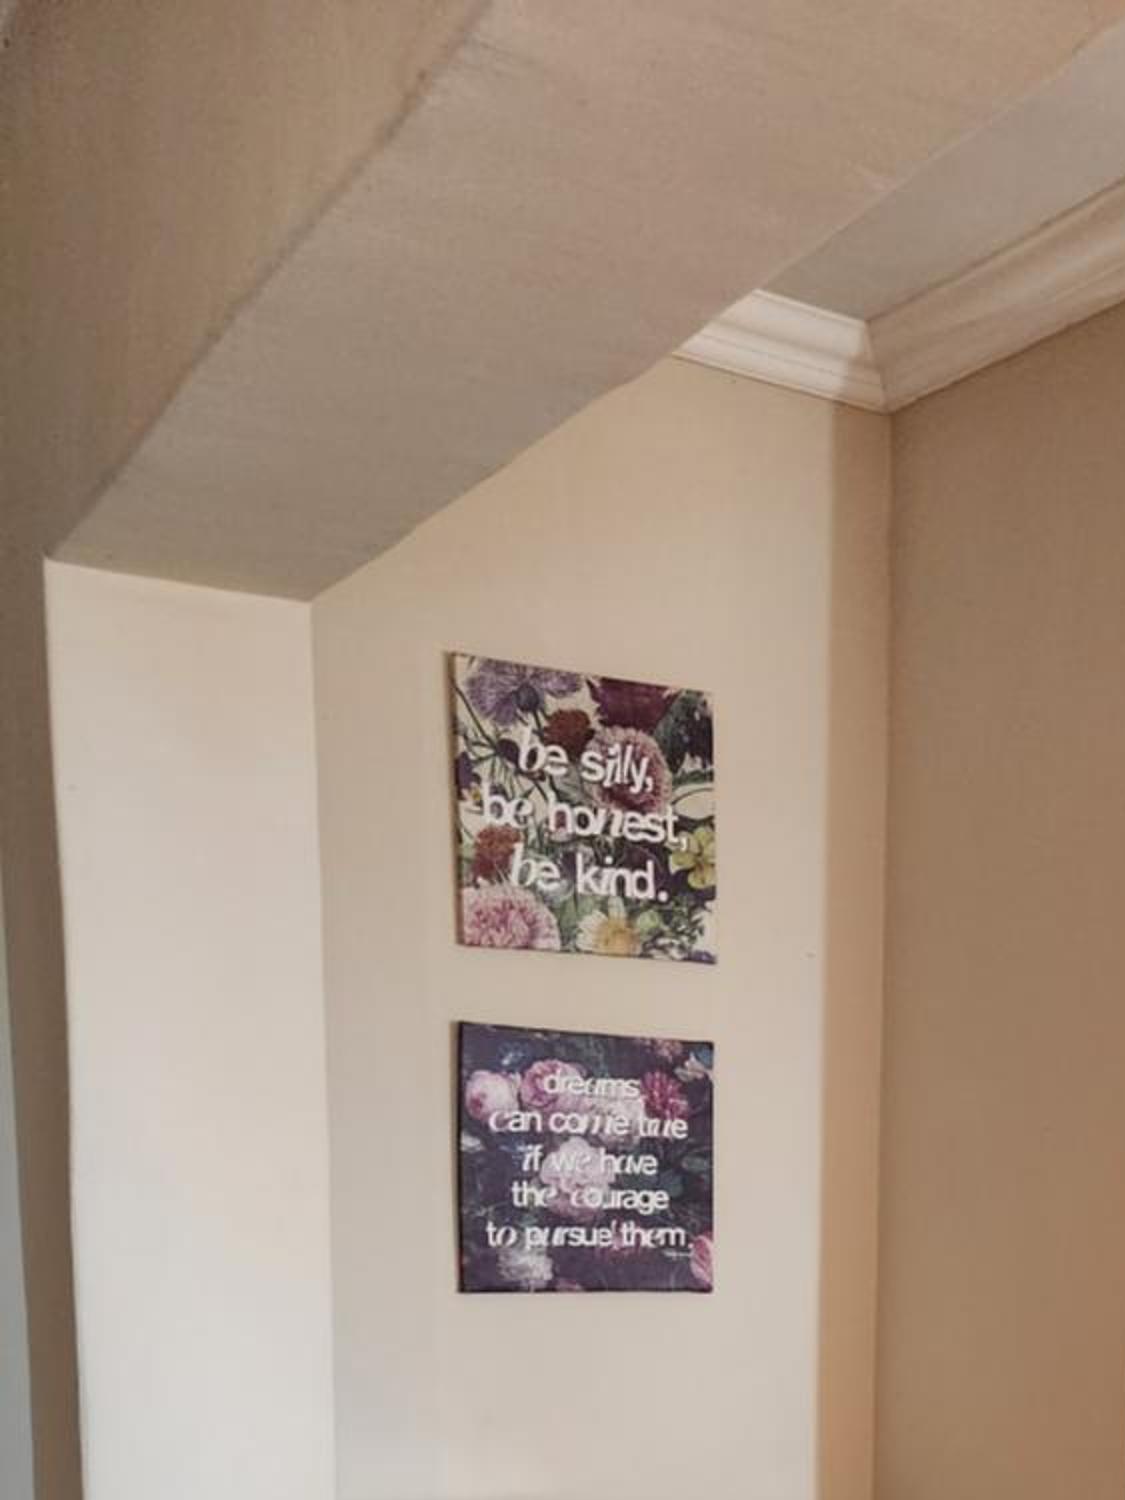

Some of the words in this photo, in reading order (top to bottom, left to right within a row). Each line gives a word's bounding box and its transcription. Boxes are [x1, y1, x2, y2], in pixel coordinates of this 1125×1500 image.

[518, 727, 568, 776] be
[581, 743, 652, 794] silly,
[481, 783, 533, 828] be
[549, 791, 688, 850] honest,
[510, 843, 560, 890] be
[576, 852, 668, 902] kind.
[543, 1073, 640, 1098] dreams
[489, 1110, 542, 1133] can
[550, 1110, 628, 1136] come
[638, 1113, 688, 1139] true
[522, 1144, 544, 1172] if
[550, 1150, 590, 1170] we
[600, 1148, 659, 1175] have
[511, 1181, 557, 1208] the
[570, 1188, 670, 1215] courage
[486, 1222, 517, 1247] to
[525, 1225, 613, 1250] pursue
[620, 1220, 694, 1248] them.
